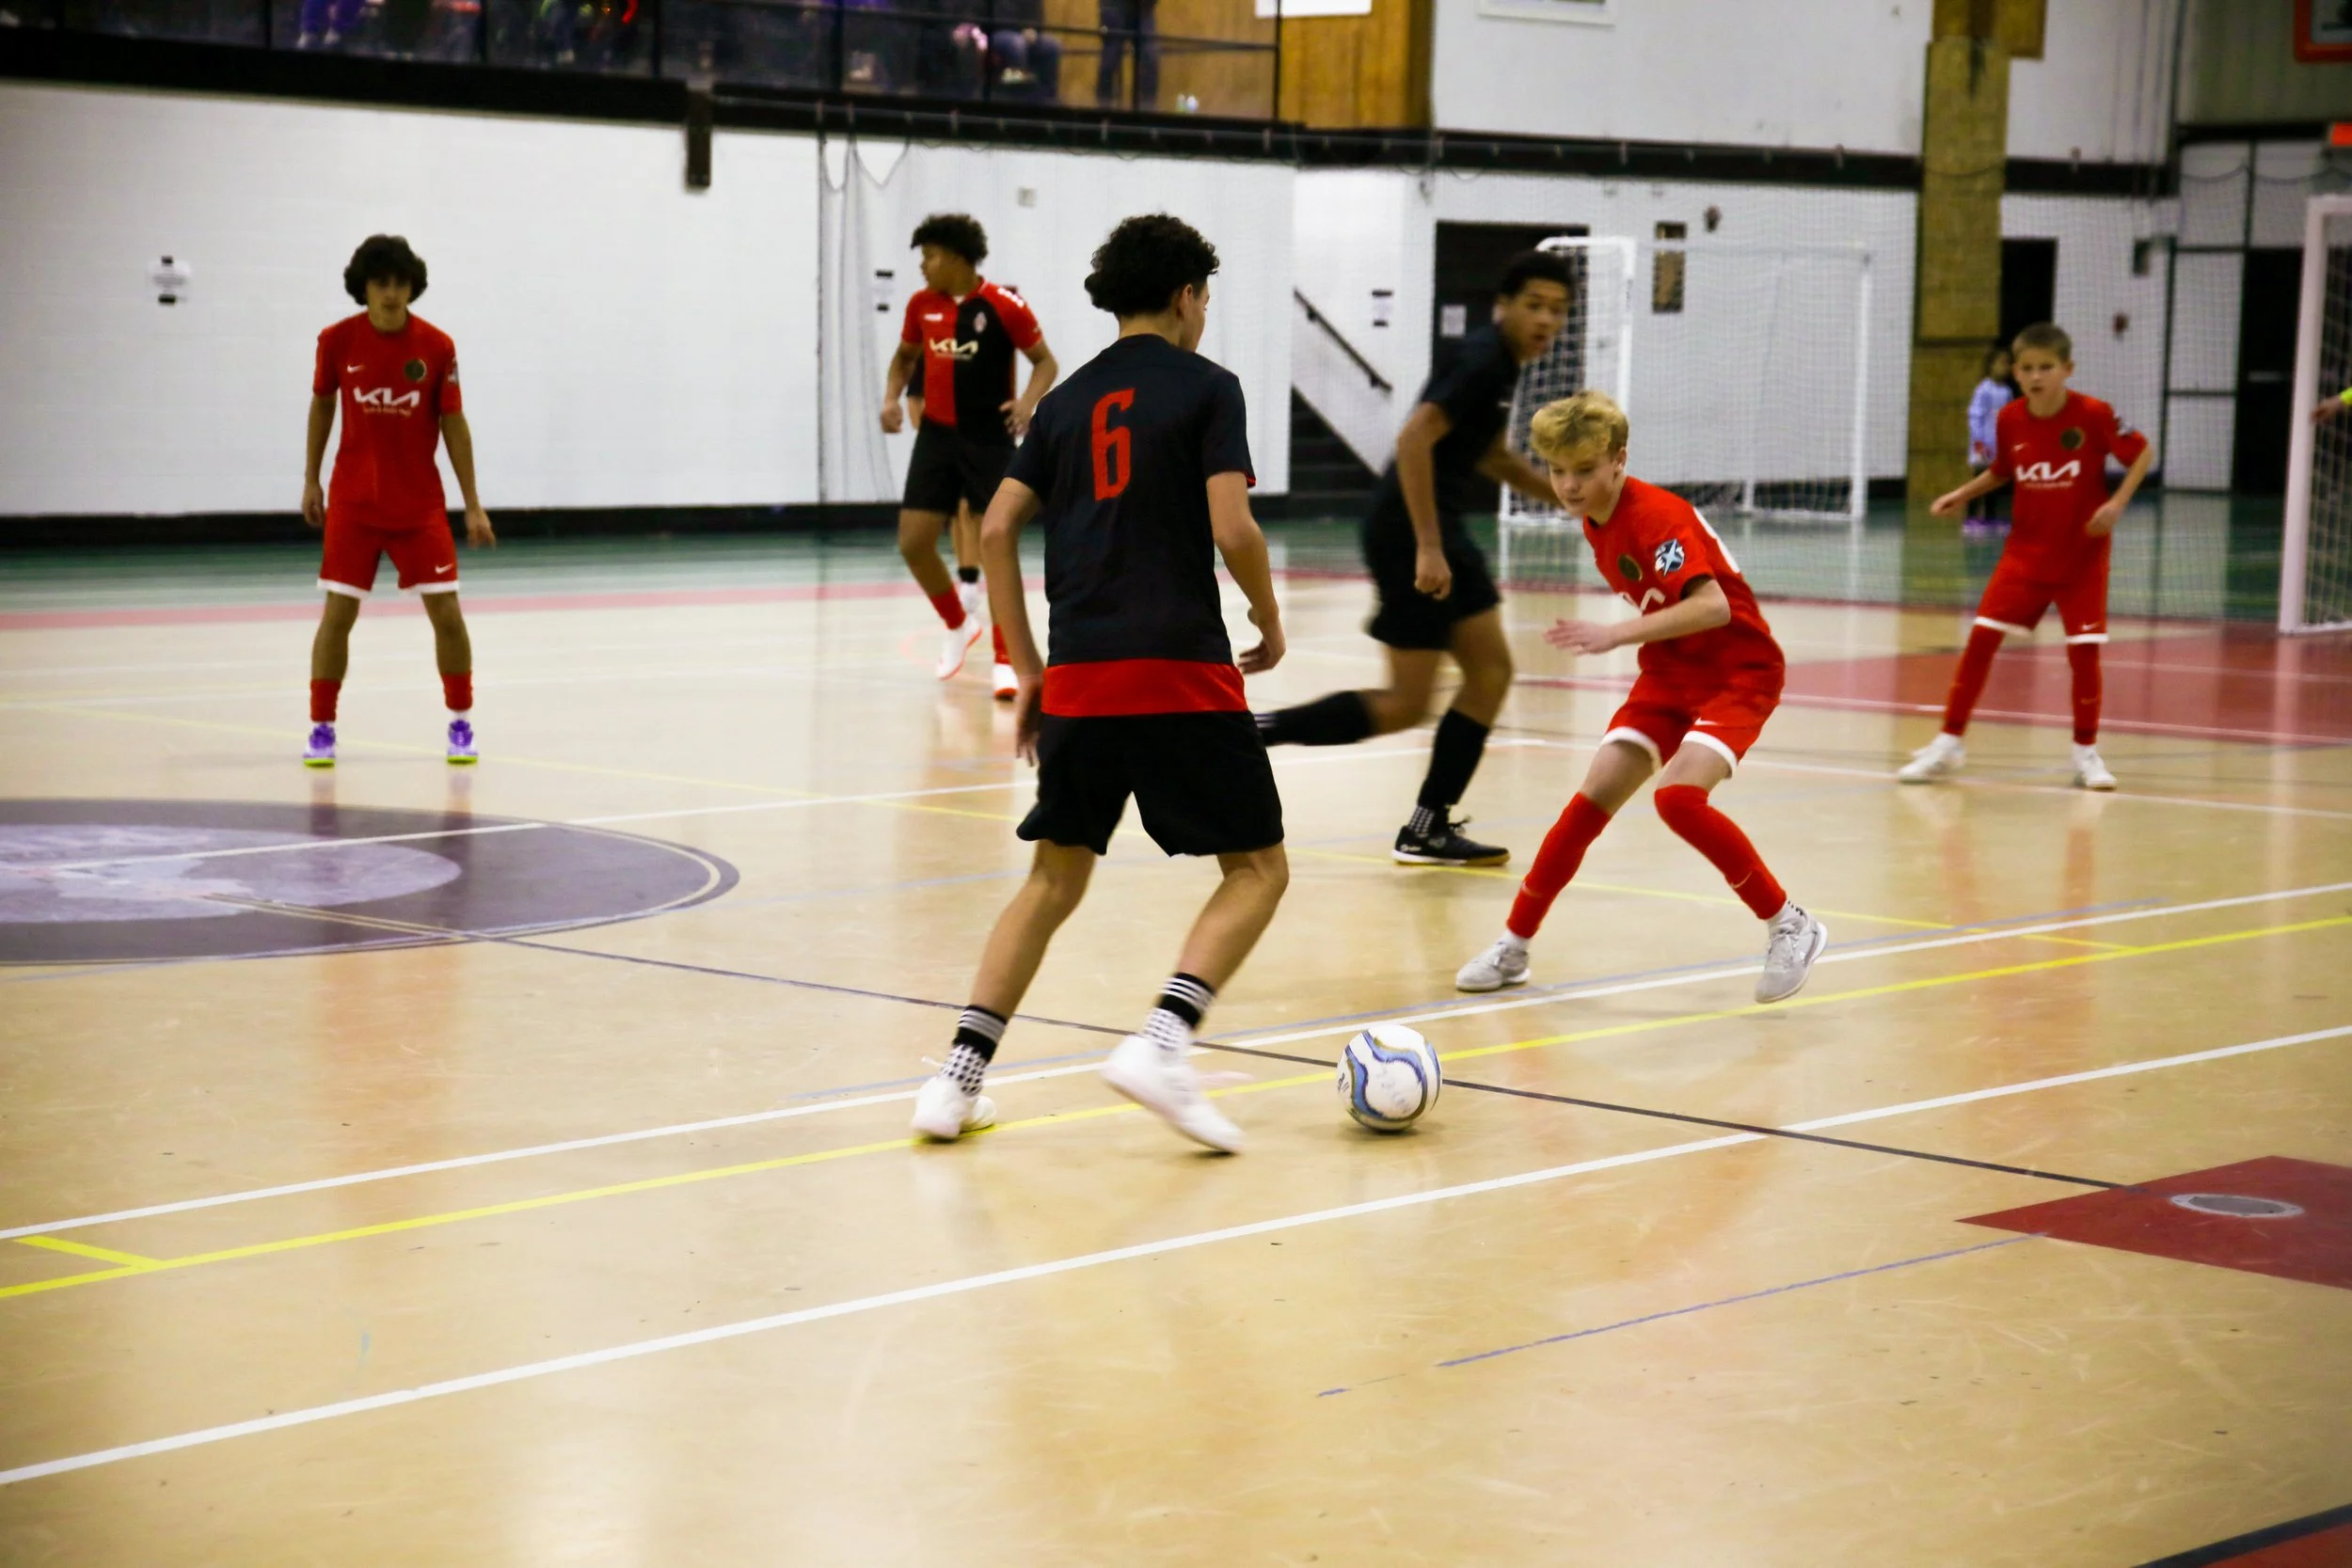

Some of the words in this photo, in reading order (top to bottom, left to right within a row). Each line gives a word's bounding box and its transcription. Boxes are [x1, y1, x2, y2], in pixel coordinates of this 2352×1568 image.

[929, 336, 979, 354] KIA
[353, 386, 421, 407] KIA
[1091, 388, 1136, 501] 6
[2015, 460, 2081, 482] KIA
